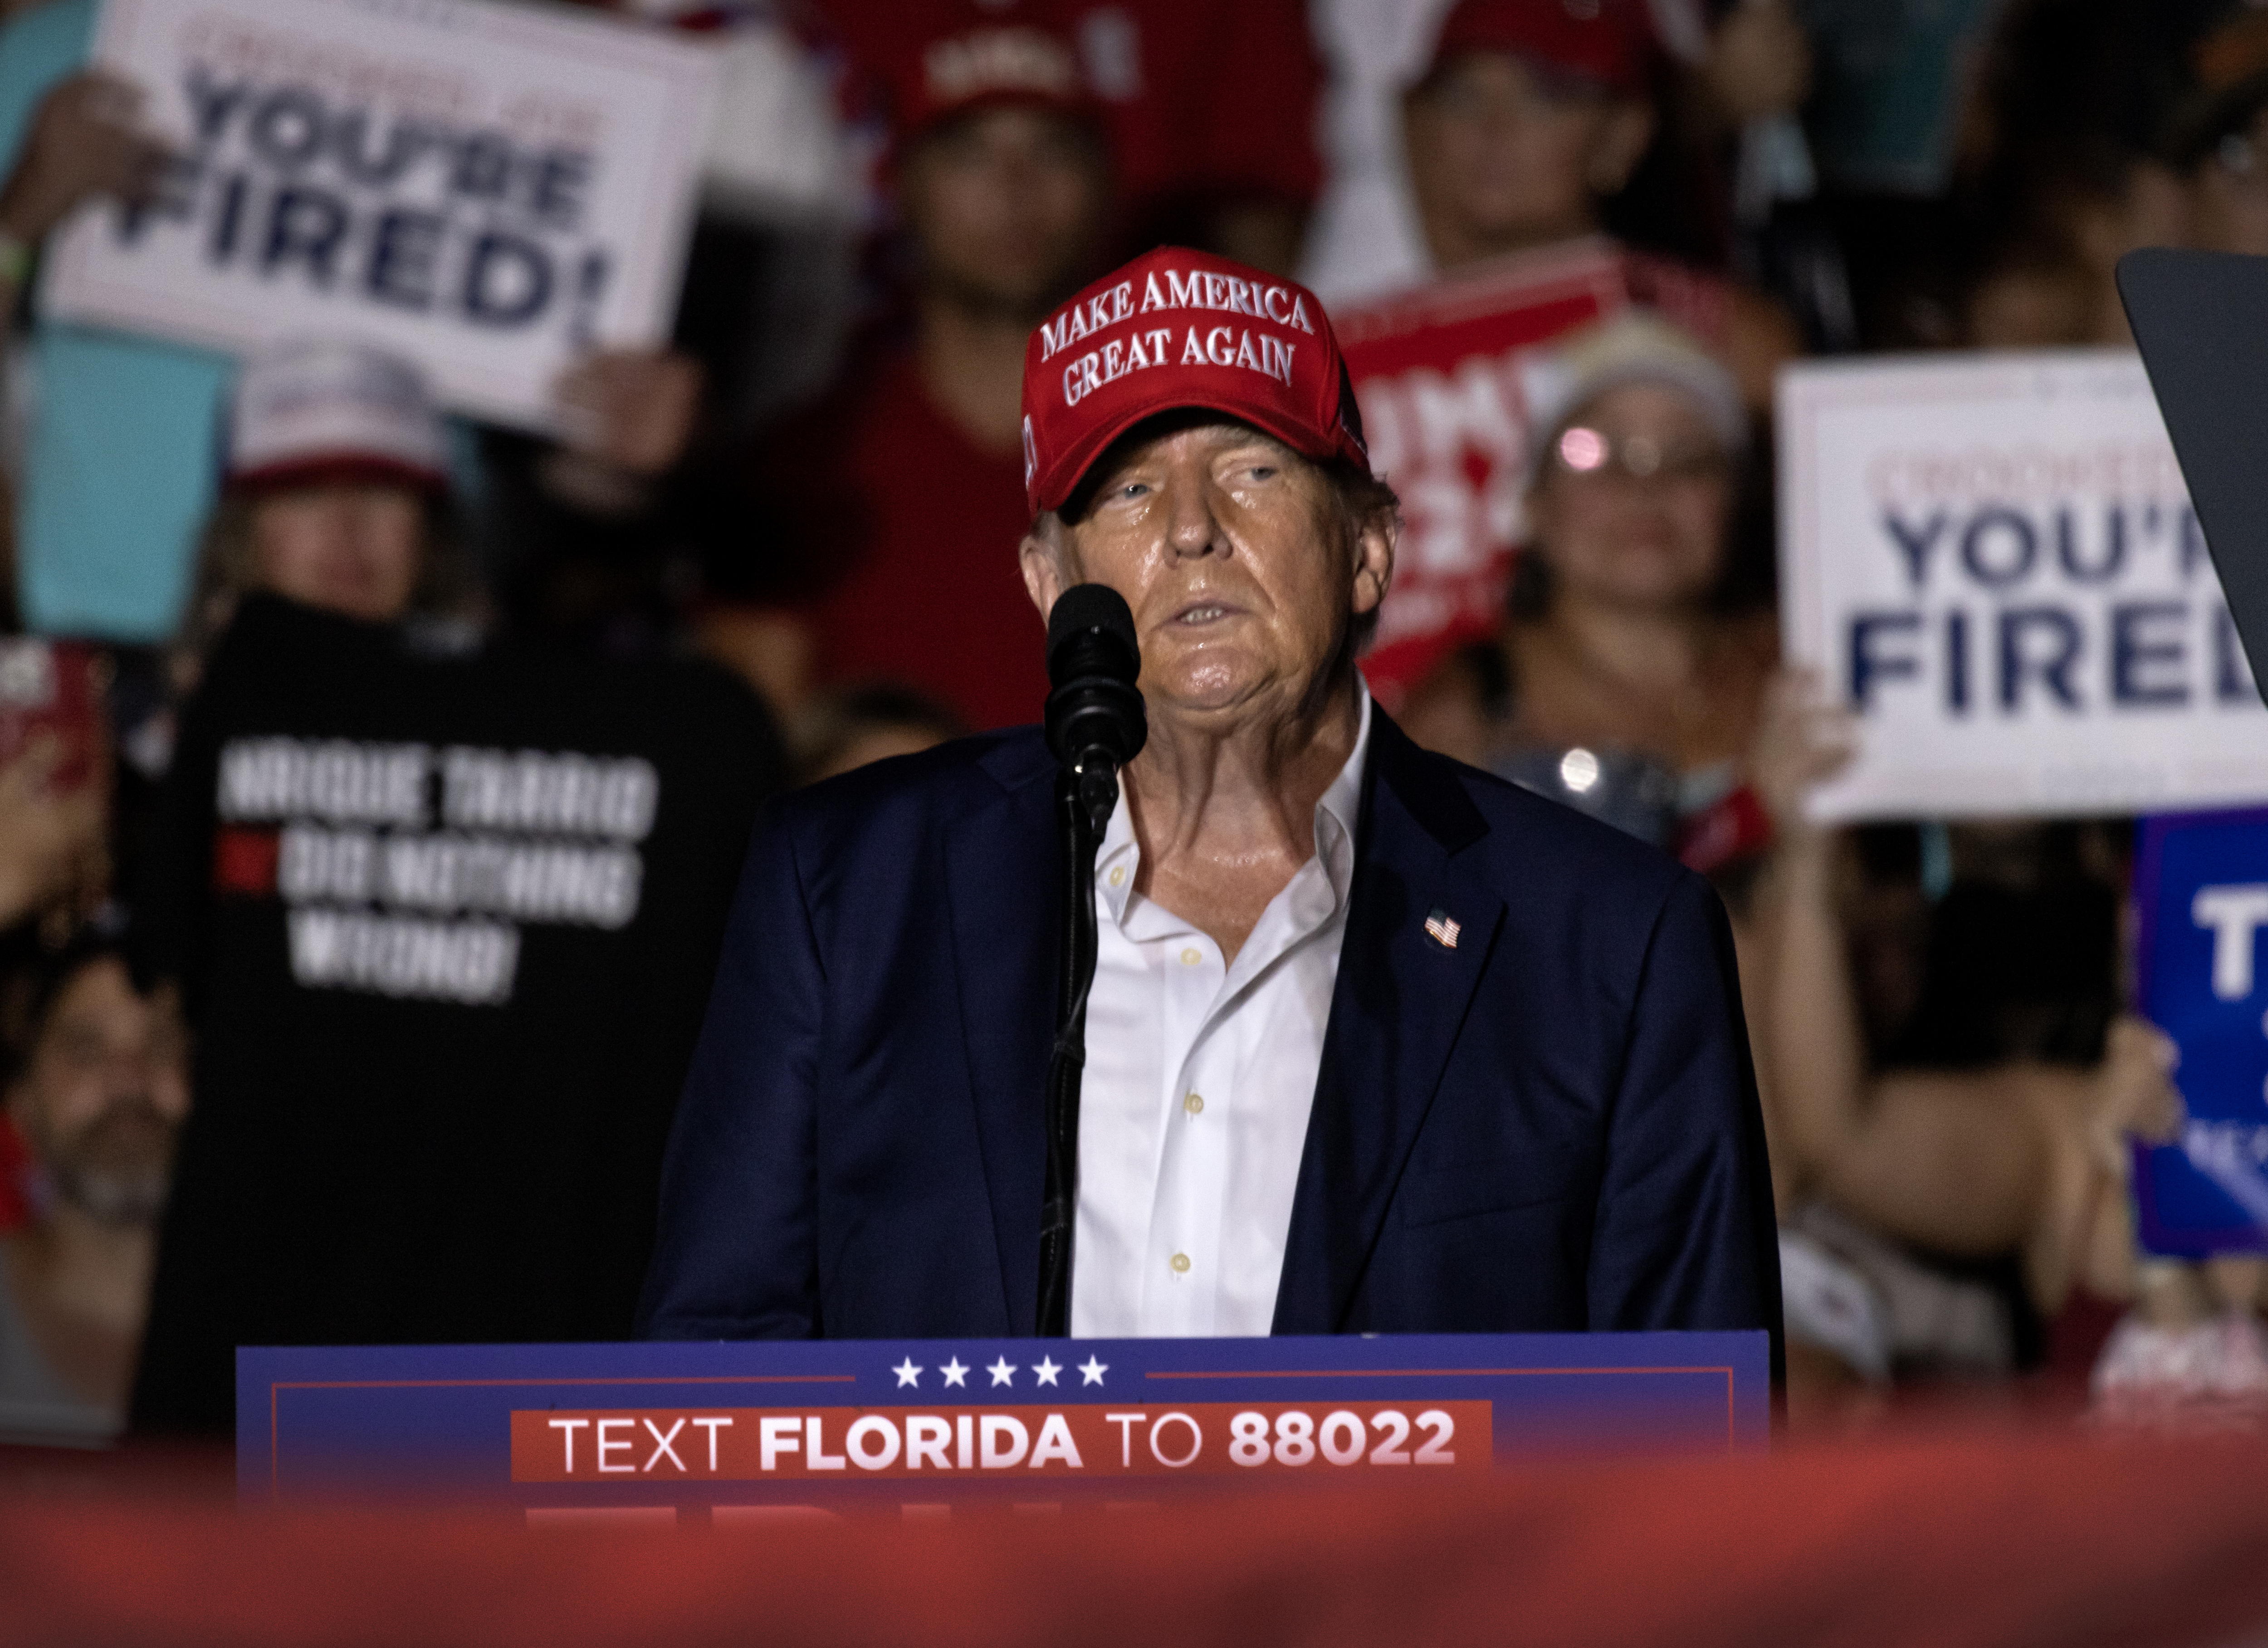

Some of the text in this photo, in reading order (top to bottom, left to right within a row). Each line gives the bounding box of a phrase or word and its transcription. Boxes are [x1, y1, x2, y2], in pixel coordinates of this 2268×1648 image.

[185, 59, 593, 227] YOU'RE
[1041, 269, 1315, 362] MAKE AMERICA
[1062, 325, 1296, 407] GREAT AGAIN
[384, 831, 642, 928] NOTHING
[548, 1409, 1455, 1473] TEXT FLORIDA TO 88022
